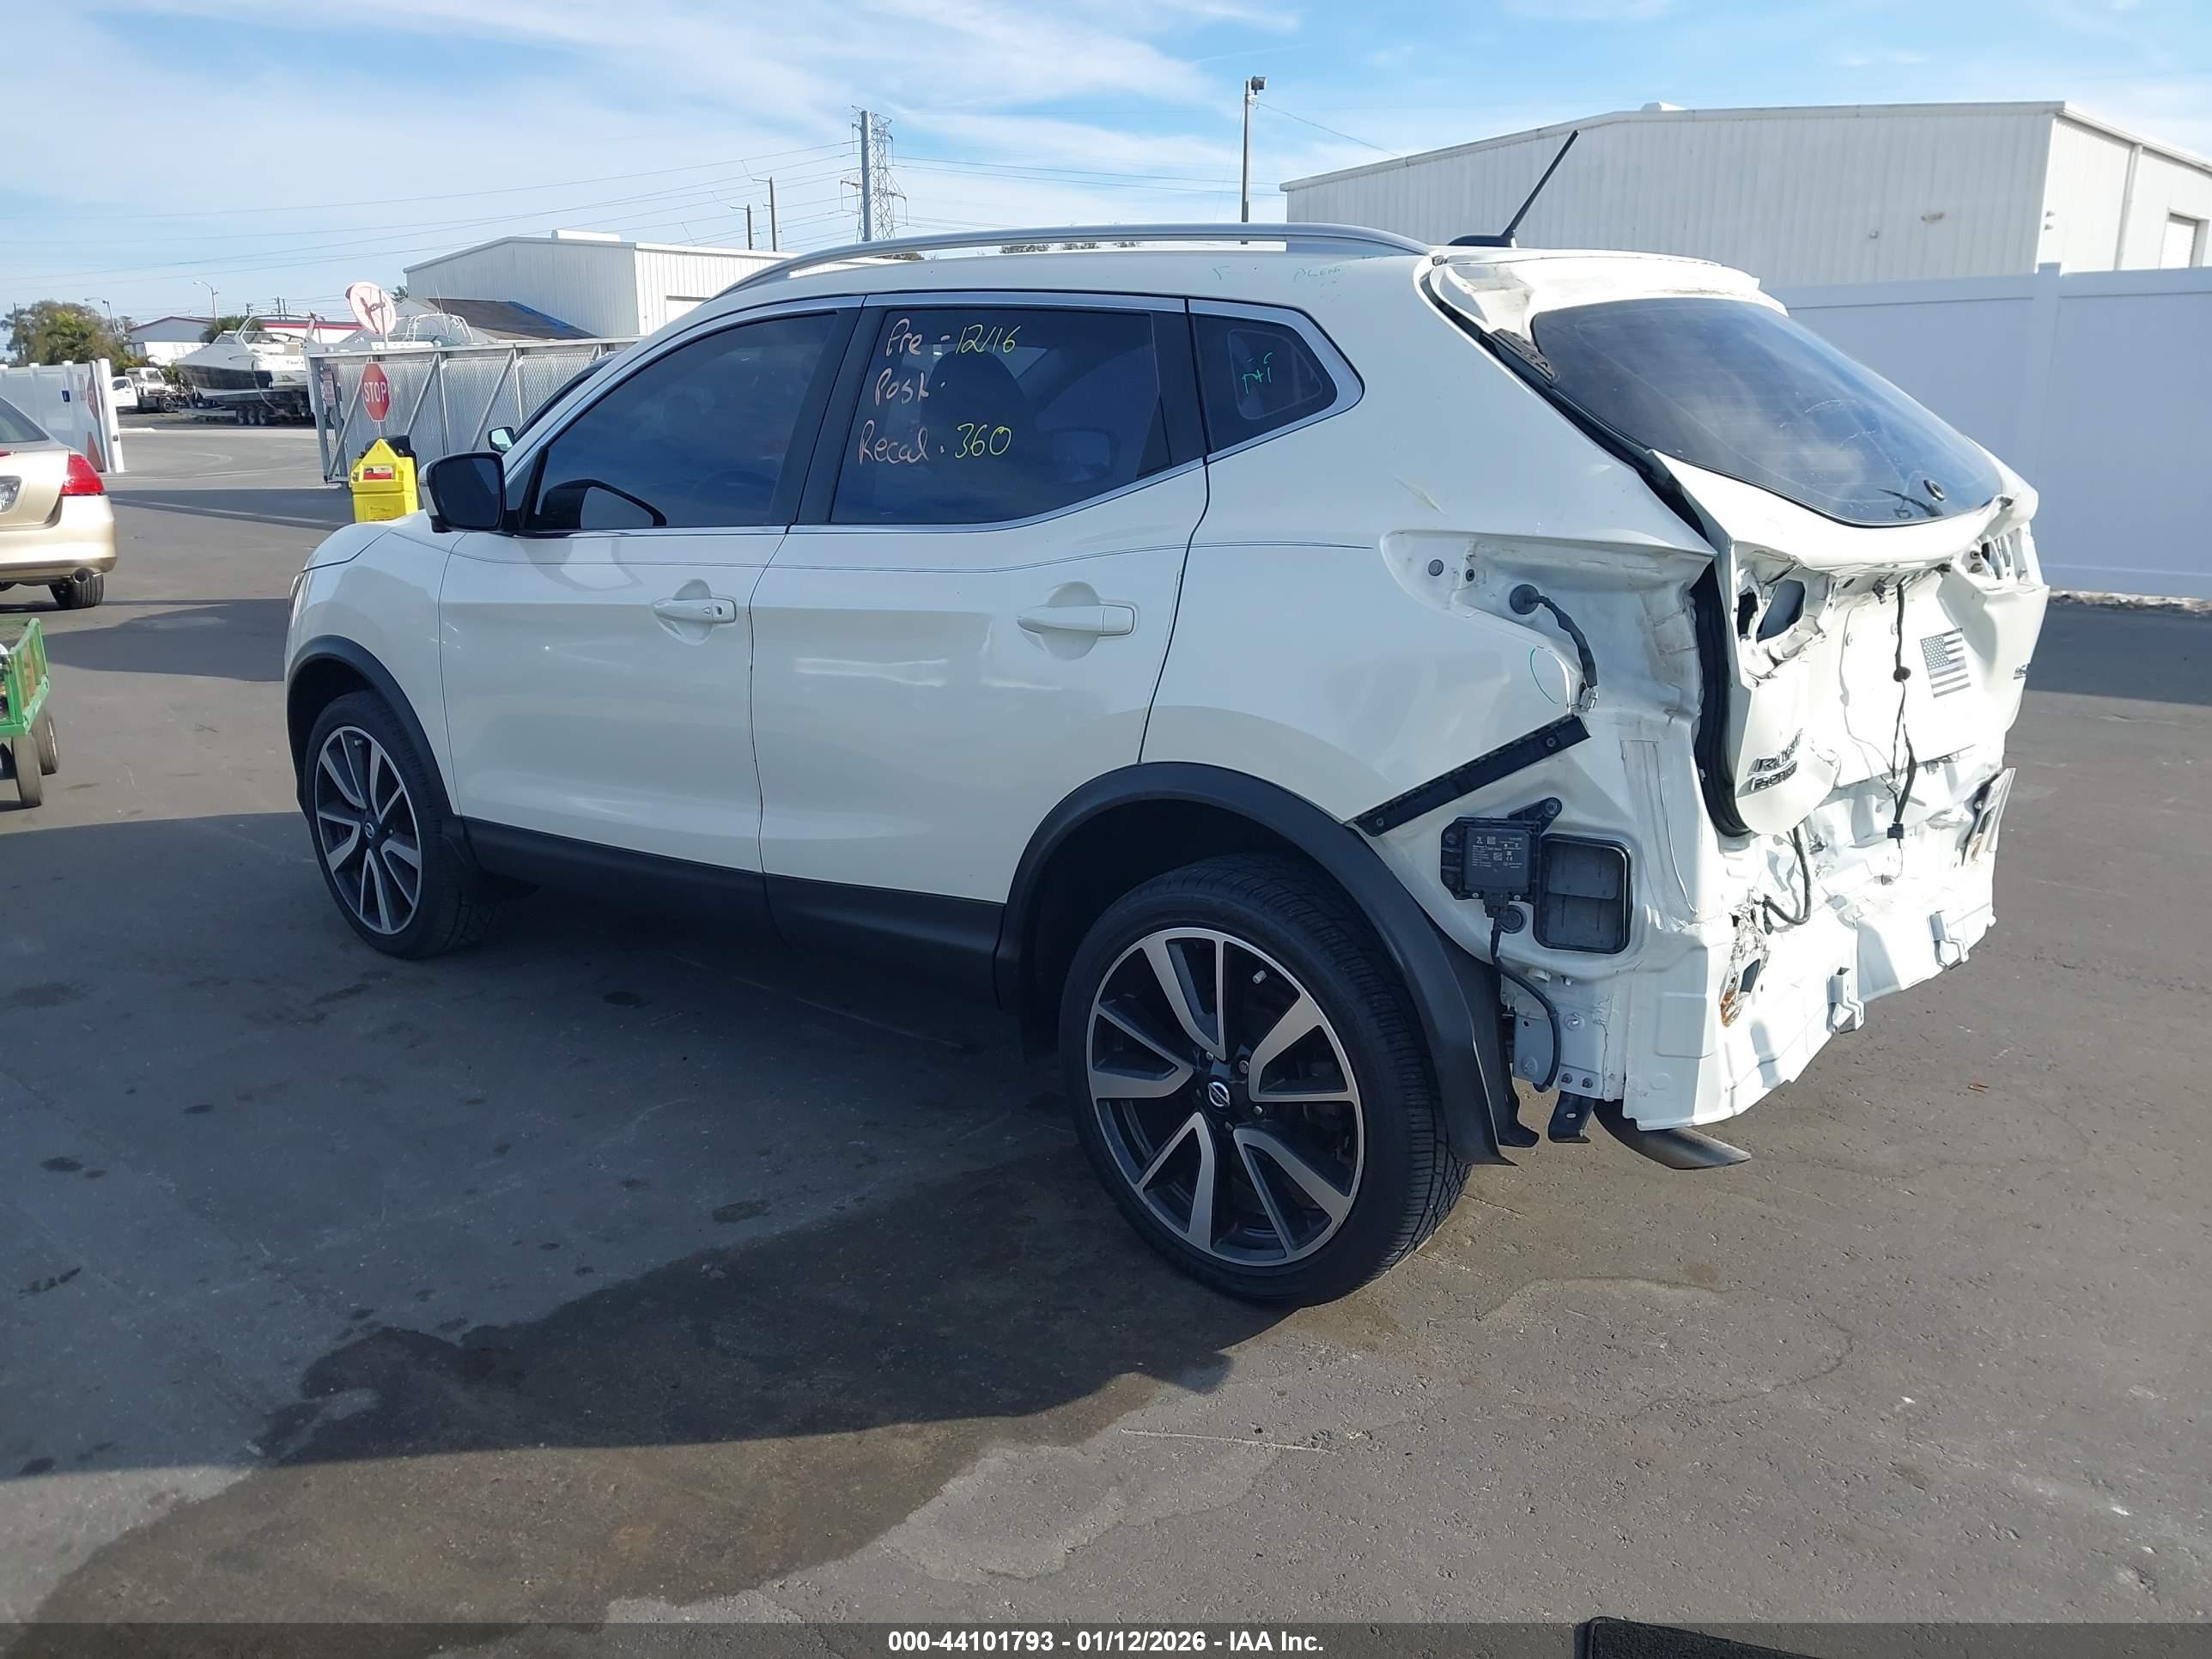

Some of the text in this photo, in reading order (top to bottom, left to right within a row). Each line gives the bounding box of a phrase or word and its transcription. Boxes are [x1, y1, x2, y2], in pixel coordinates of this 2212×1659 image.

[886, 318, 922, 356] Pre
[955, 324, 1022, 355] 12/16
[363, 381, 386, 403] STOP
[955, 423, 1012, 459] 360
